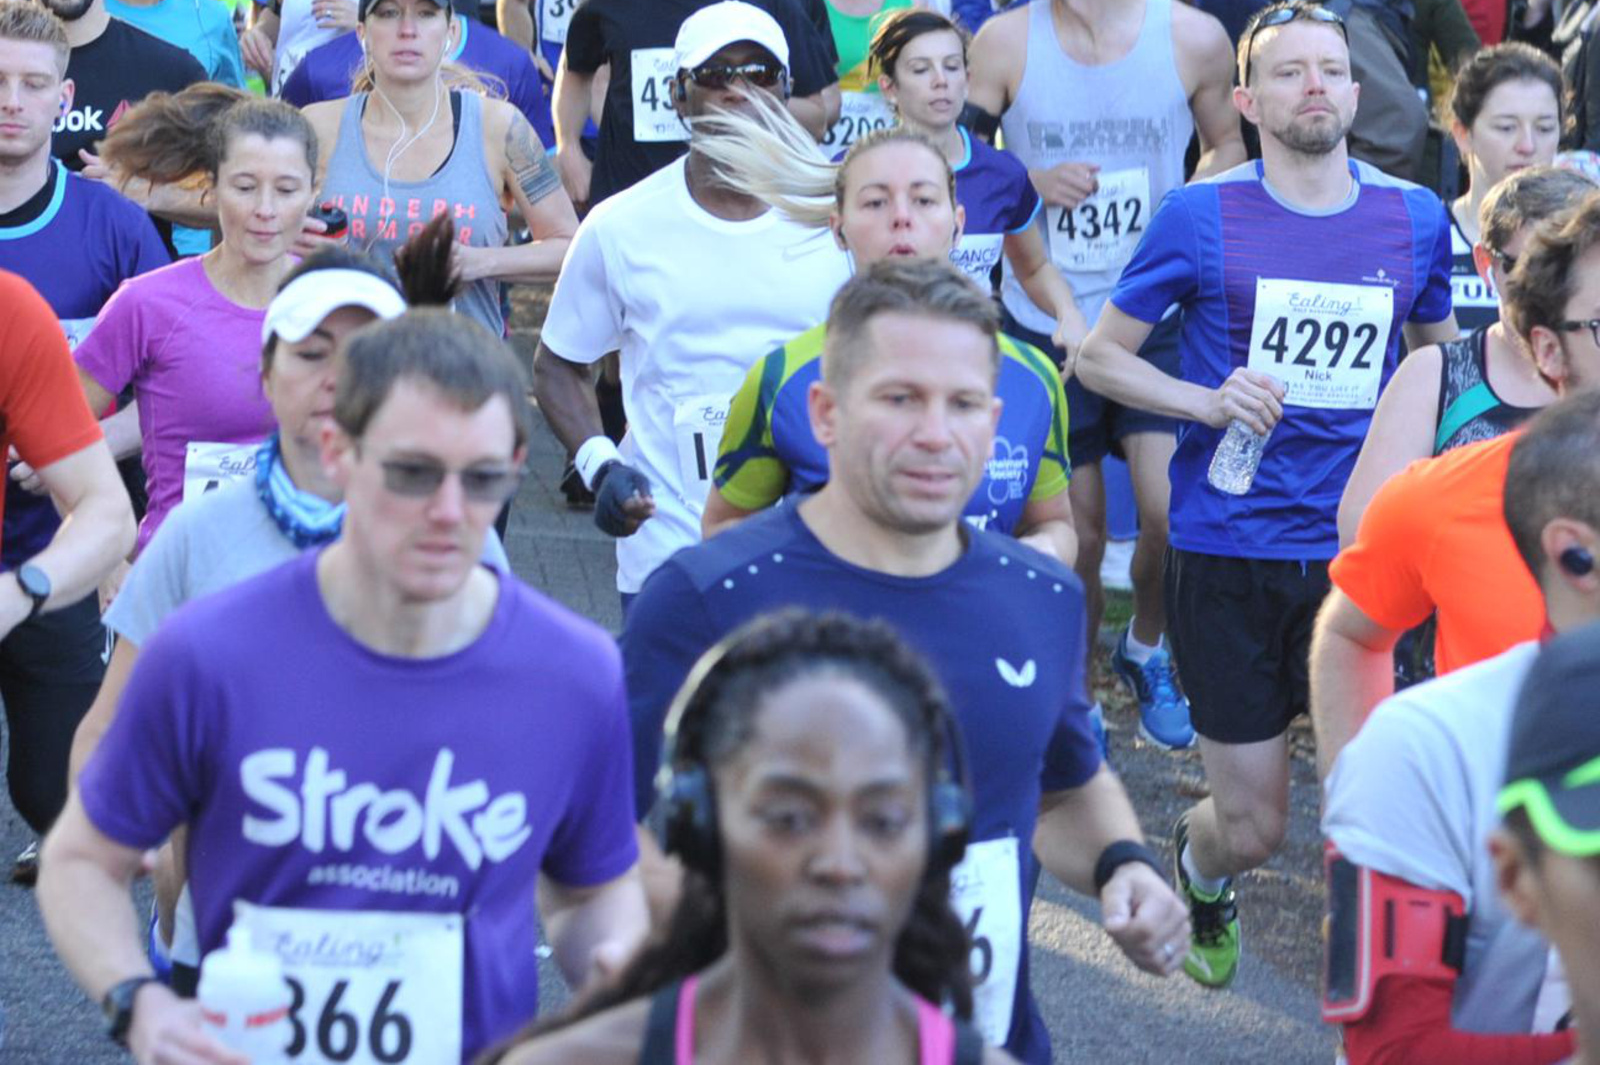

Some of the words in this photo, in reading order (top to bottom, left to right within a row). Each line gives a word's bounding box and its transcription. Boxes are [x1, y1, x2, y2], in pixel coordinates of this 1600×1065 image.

[1056, 197, 1142, 241] 4342
[1261, 316, 1379, 369] 4292
[1304, 369, 1333, 381] Nick
[240, 746, 531, 870] Stroke
[307, 863, 458, 898] association
